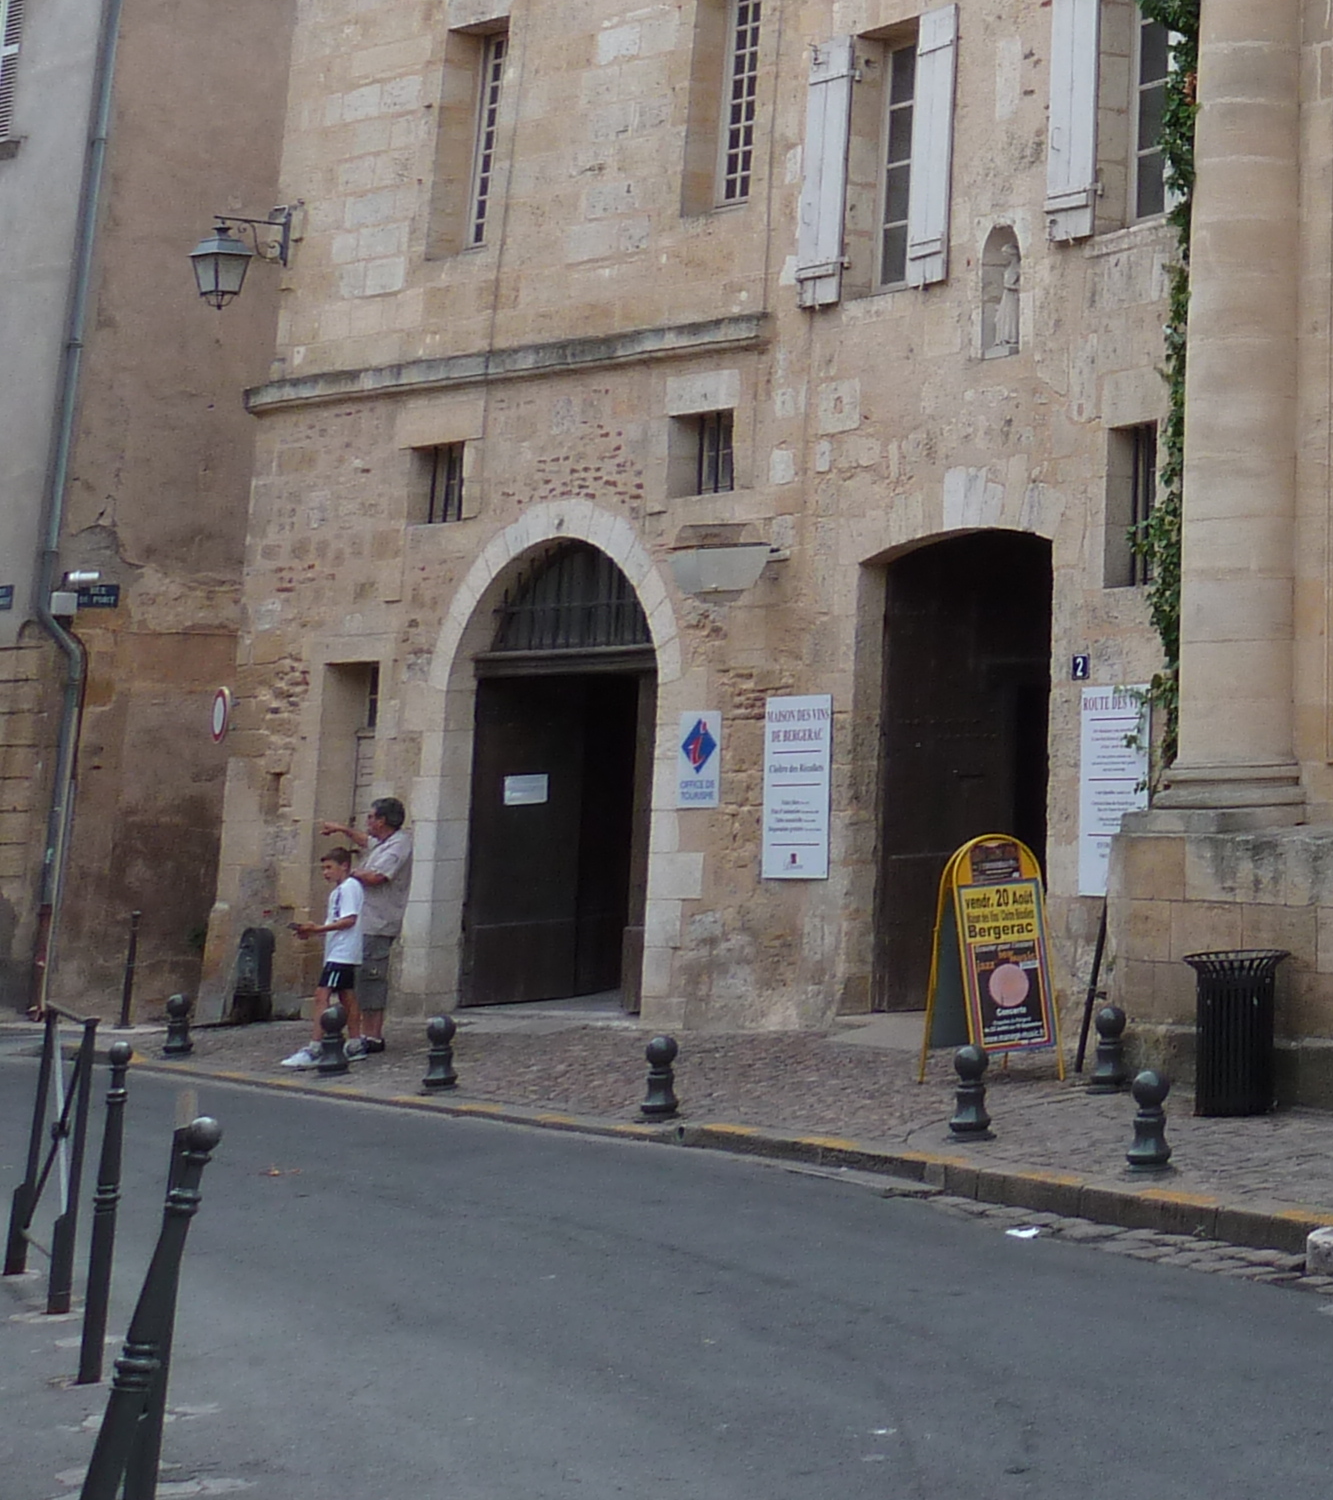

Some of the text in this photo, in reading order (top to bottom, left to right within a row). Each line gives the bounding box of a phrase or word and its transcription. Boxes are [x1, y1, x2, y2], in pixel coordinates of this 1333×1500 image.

[1076, 657, 1084, 677] 2
[1083, 695, 1110, 711] ROUTE
[1112, 694, 1127, 710] DES
[679, 779, 715, 791] OFFICE DE
[996, 888, 1010, 907] 20
[968, 922, 1034, 939] Bergerac
